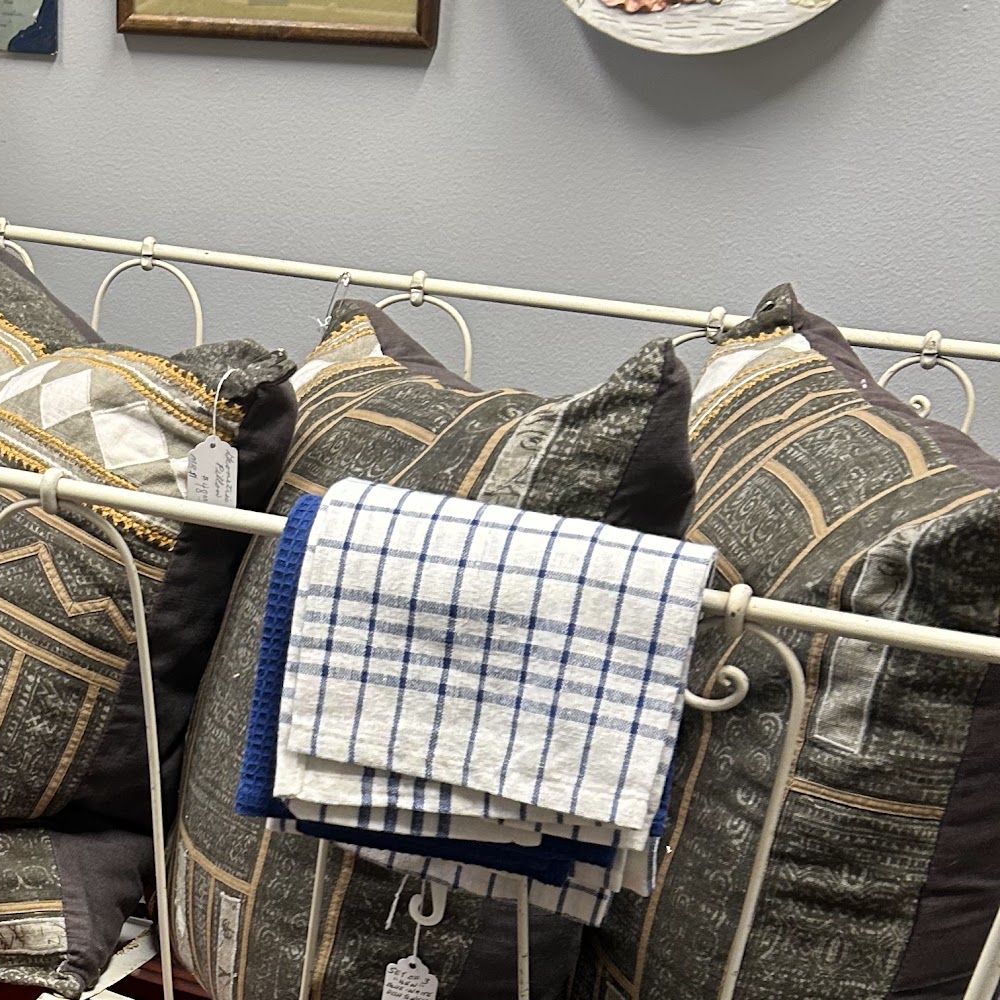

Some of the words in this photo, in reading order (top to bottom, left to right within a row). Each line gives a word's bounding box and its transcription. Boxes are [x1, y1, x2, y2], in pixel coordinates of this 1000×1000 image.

[215, 462, 225, 498] Pillow
[387, 967, 407, 978] SET
[421, 977, 431, 985] 3
